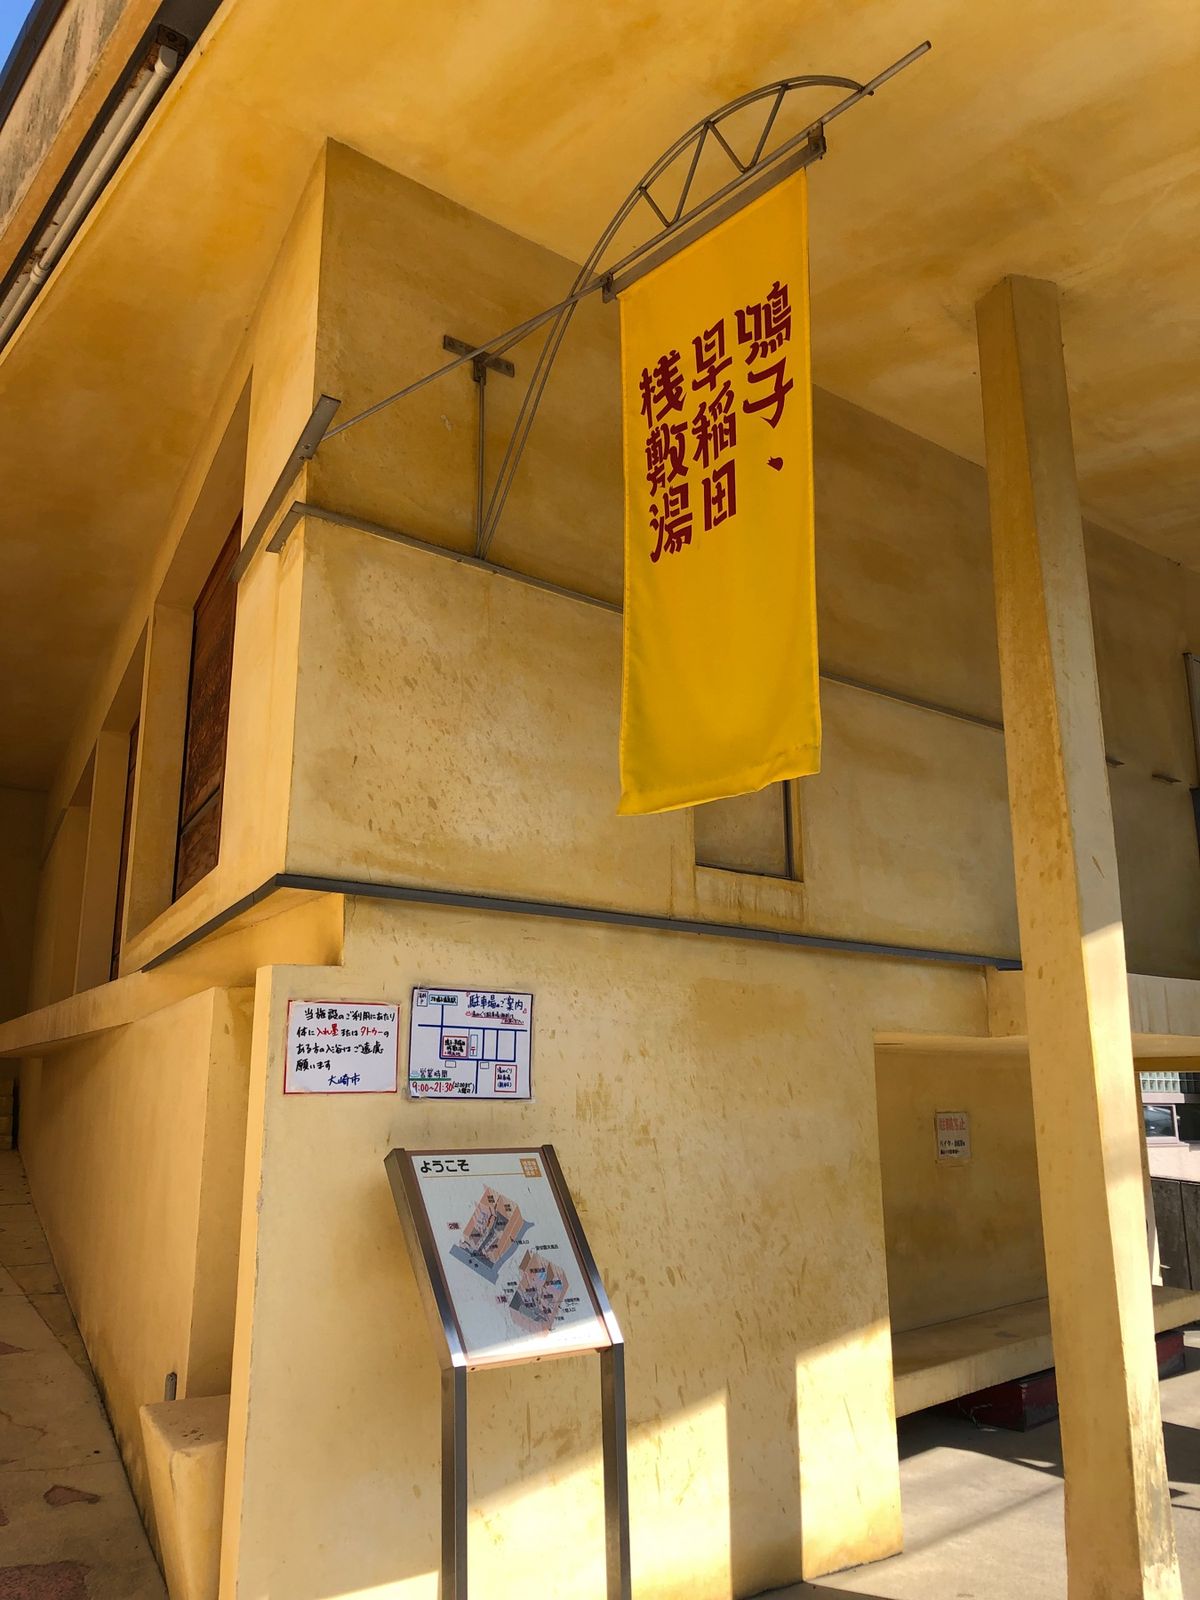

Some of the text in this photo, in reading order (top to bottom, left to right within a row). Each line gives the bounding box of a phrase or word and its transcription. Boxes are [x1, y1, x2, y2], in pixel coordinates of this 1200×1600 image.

[691, 318, 737, 532] 早稲田
[639, 349, 693, 563] 桟敷湯
[304, 1008, 395, 1022] 当施設のご利用にあたり
[295, 1058, 331, 1072] 願います
[328, 1072, 361, 1087] 大崎市
[420, 1159, 470, 1173] ようこそ
